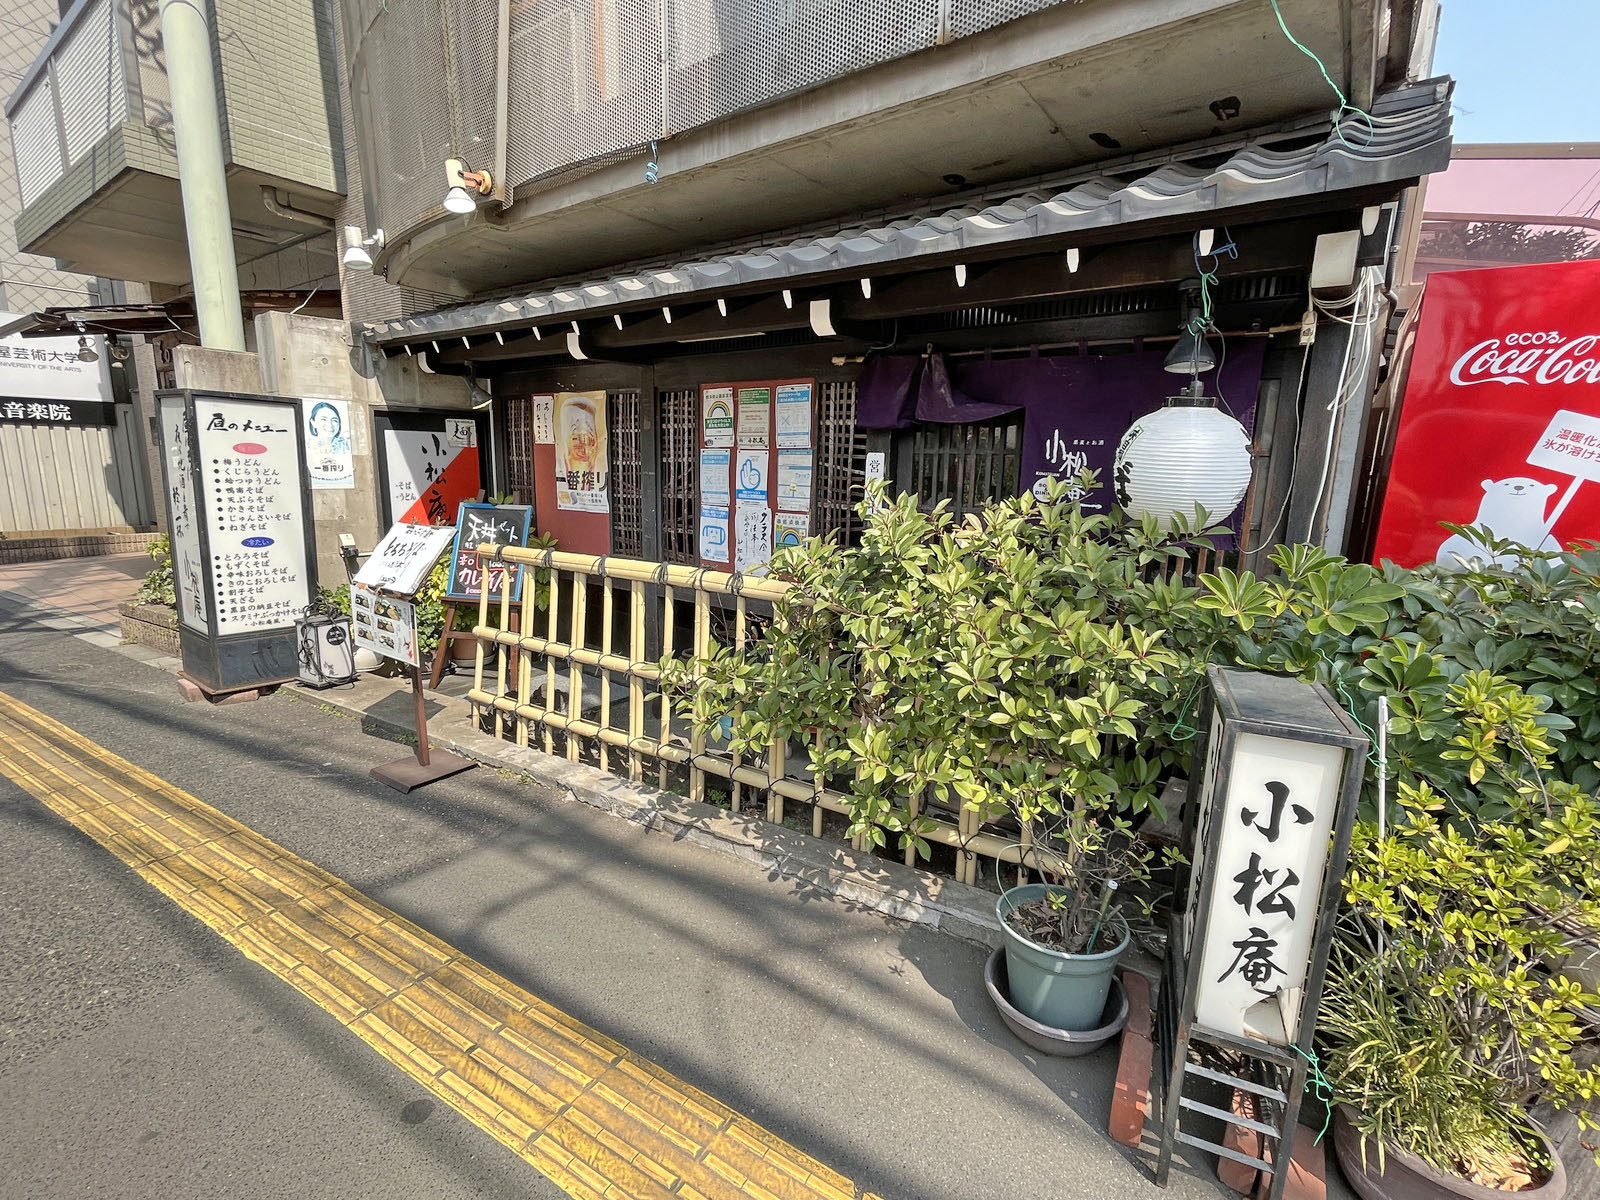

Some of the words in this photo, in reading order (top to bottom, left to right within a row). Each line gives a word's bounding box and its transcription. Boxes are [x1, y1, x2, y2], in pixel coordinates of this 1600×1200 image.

[207, 412, 288, 433] 昼のメニュー
[399, 493, 417, 501] うどん
[1217, 780, 1315, 996] 小松庵
